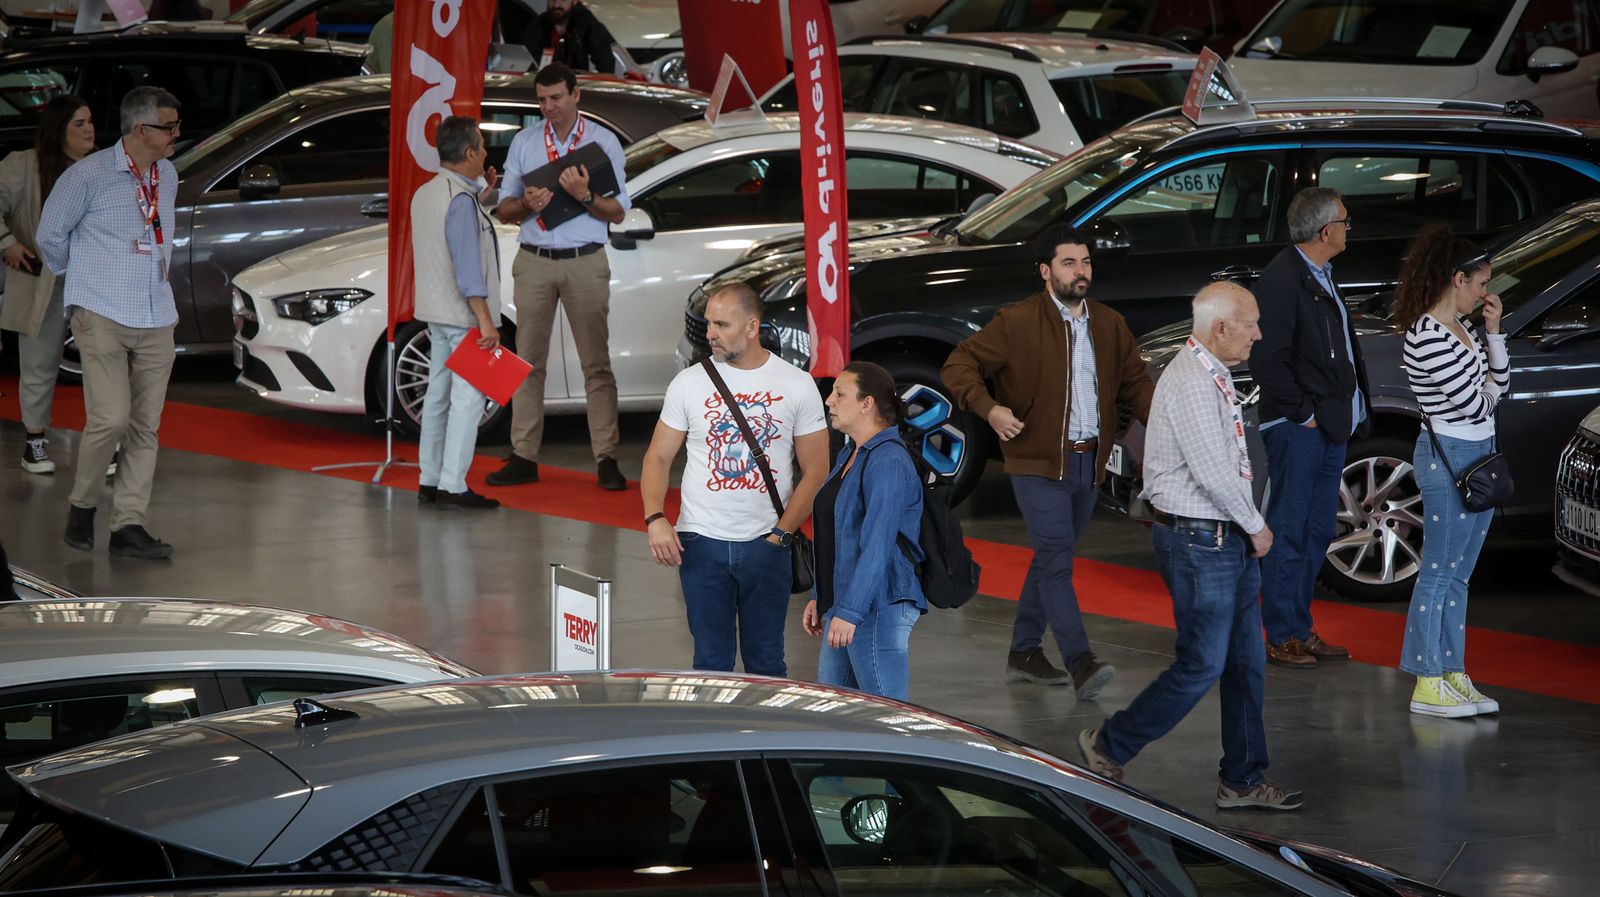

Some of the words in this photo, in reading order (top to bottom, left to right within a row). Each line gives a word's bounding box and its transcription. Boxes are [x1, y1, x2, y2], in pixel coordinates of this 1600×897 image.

[704, 391, 784, 409] Snes
[705, 429, 782, 448] Stos
[563, 612, 598, 647] TERRY
